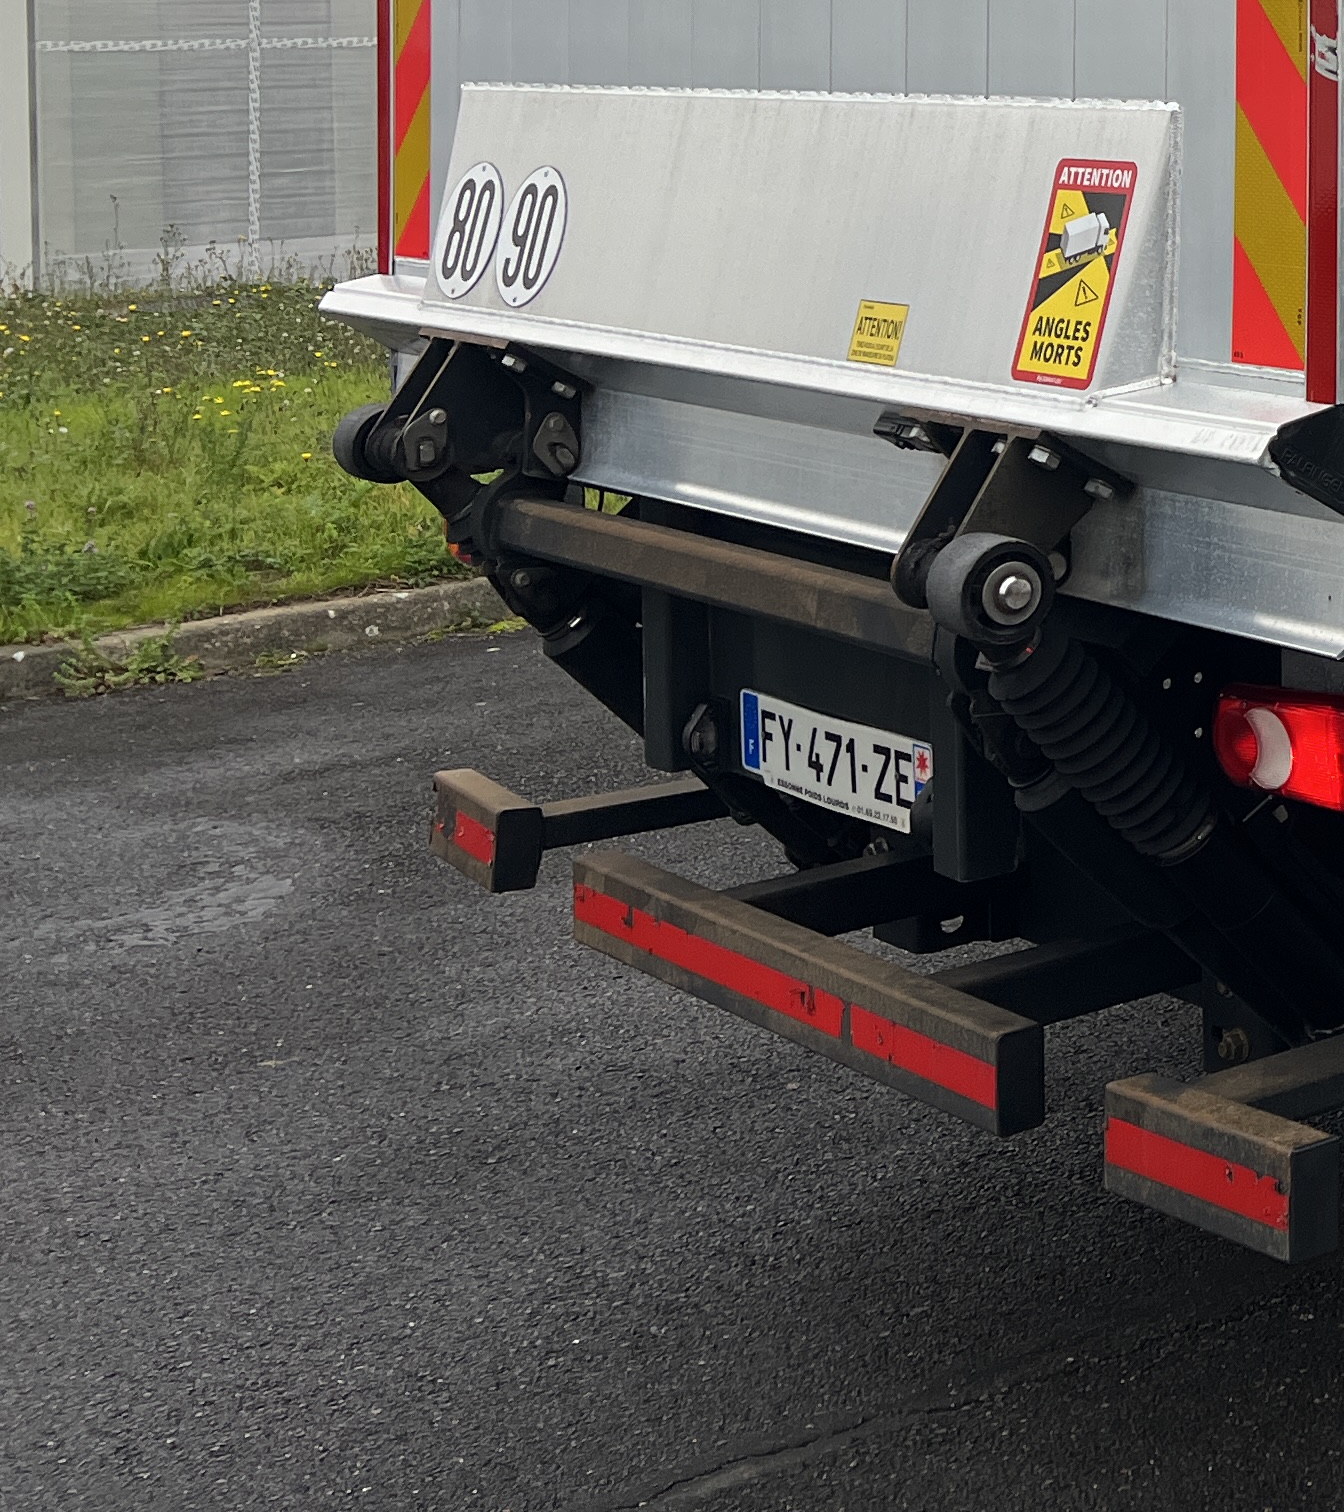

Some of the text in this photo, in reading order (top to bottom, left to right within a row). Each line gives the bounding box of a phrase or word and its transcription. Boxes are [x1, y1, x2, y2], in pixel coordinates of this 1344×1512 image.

[1058, 166, 1133, 189] ATTENTION
[441, 177, 496, 282] 80
[502, 182, 559, 291] 90
[1032, 315, 1092, 343] ANGLES
[1029, 340, 1084, 368] MORTS
